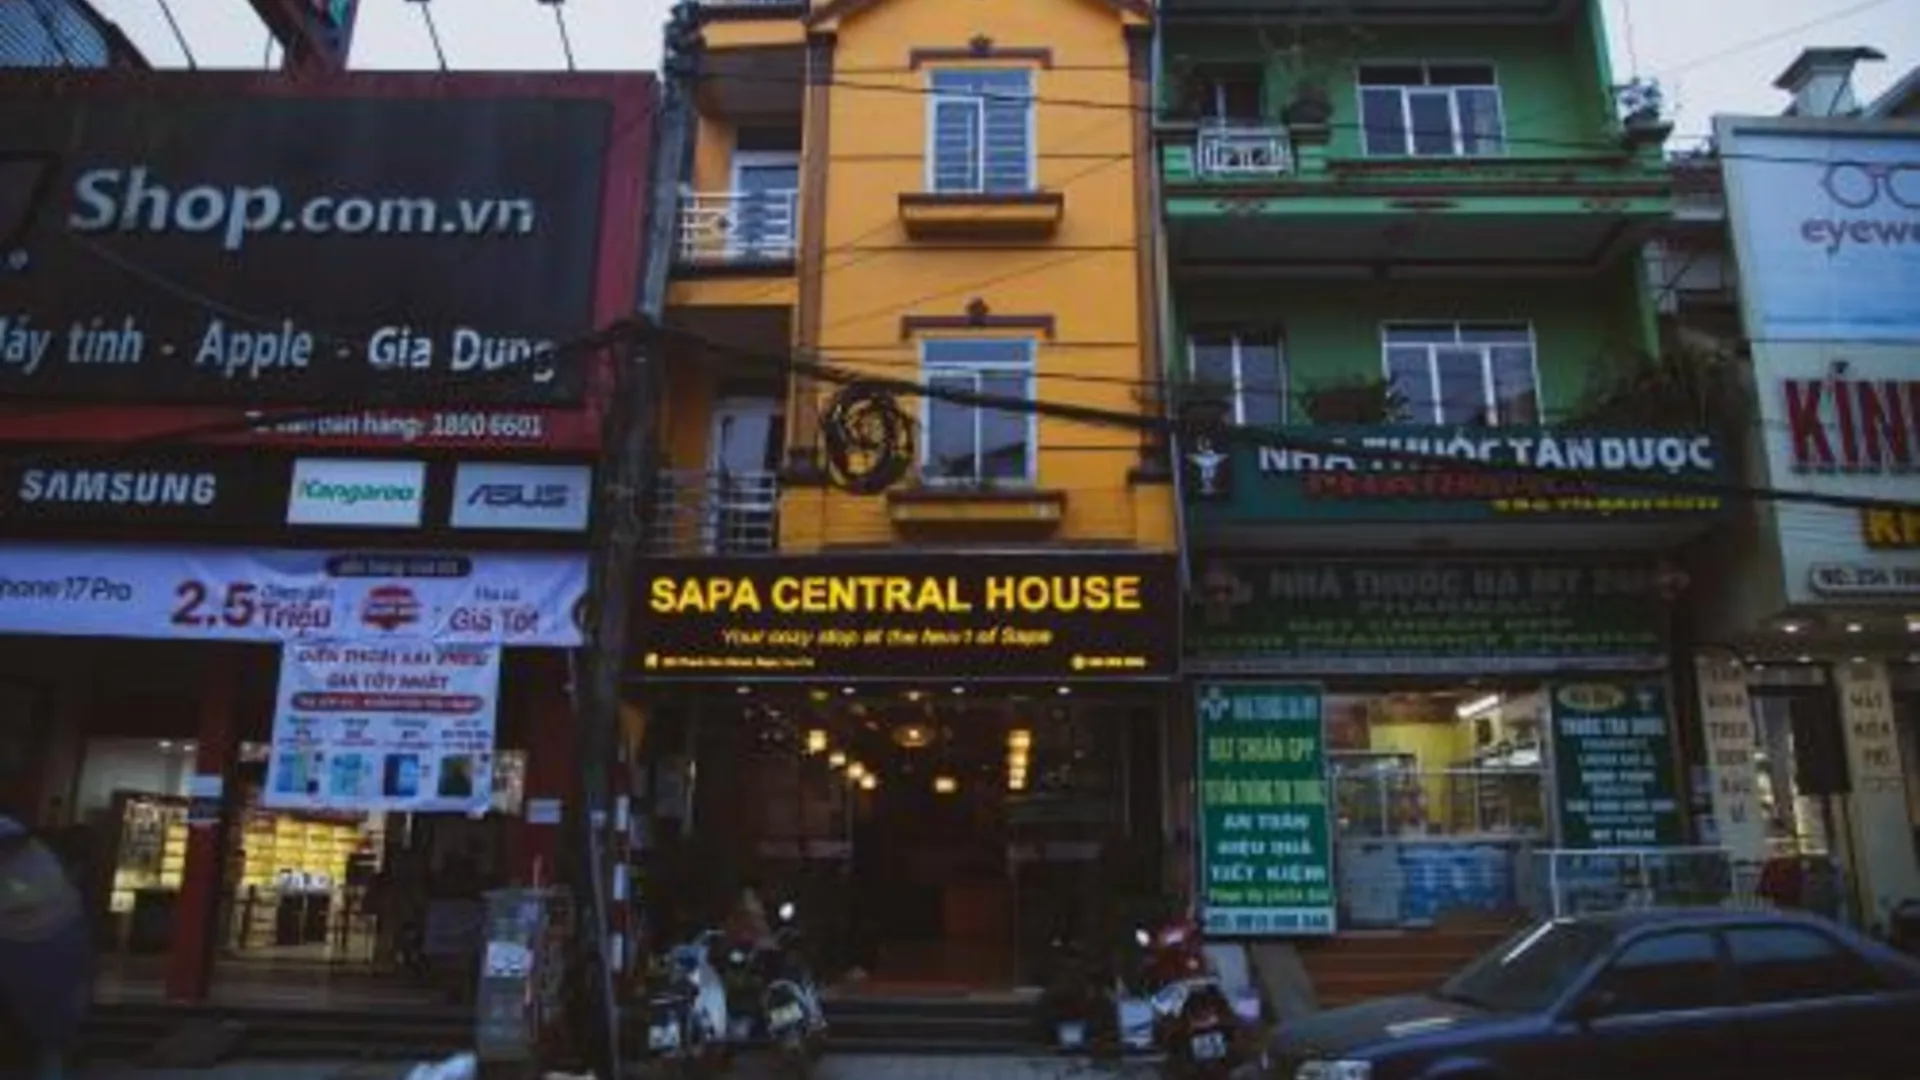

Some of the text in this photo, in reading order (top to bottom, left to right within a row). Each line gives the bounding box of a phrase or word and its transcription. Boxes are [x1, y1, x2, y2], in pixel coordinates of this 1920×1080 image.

[68, 164, 535, 251] Shop.com.vn
[0, 315, 51, 376] áy
[68, 314, 145, 363] tính
[195, 318, 313, 379] Apple
[368, 324, 433, 369] Gia
[1785, 361, 1920, 466] KÍN
[18, 468, 218, 506] SAMSUNG
[301, 479, 416, 503] Kangaroo
[467, 483, 570, 508] ASUS
[91, 576, 132, 602] Pro
[171, 578, 257, 628] 2.5
[650, 574, 1142, 613] SAPA CENTRAL HOUSE
[261, 601, 332, 635] Triệu
[449, 605, 493, 633] Giá
[722, 628, 762, 645] Your
[863, 628, 883, 645] at
[887, 628, 918, 645] the
[975, 627, 998, 645] of
[1002, 628, 1053, 647] Sapa
[1222, 812, 1253, 832] AN
